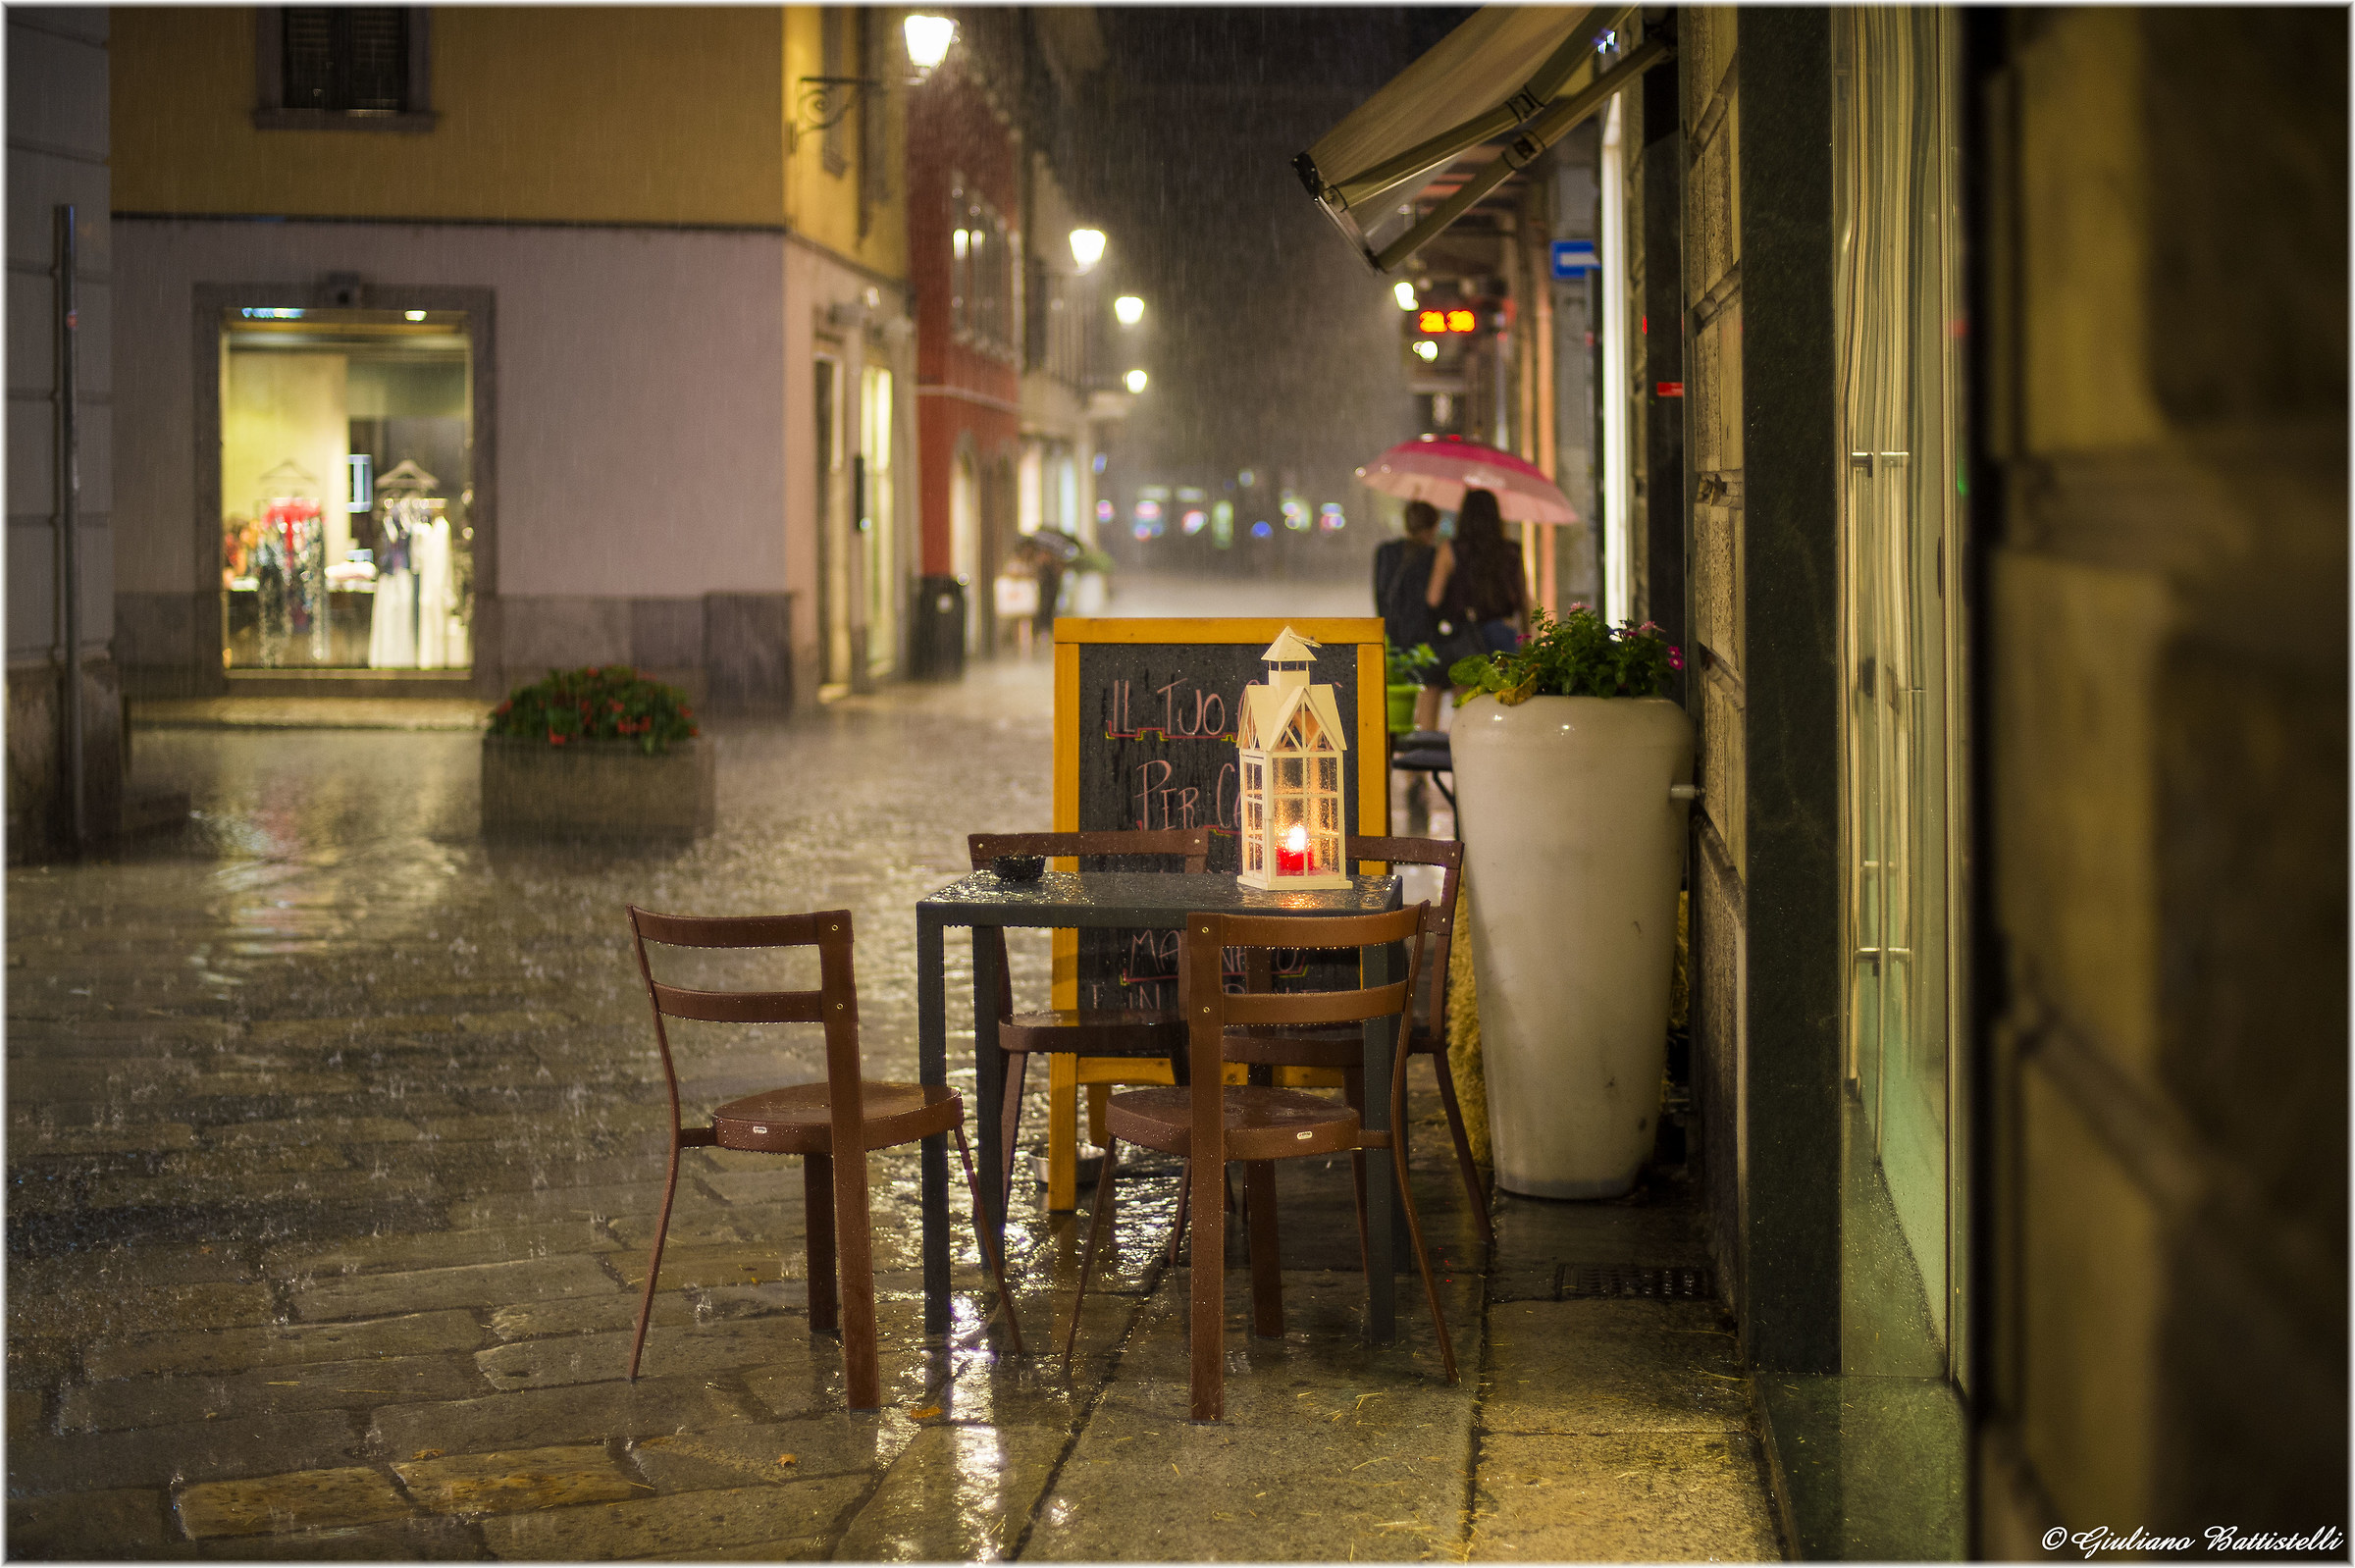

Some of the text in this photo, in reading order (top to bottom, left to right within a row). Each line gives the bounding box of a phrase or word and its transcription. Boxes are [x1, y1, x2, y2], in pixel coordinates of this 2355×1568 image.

[1113, 680, 1134, 733] IL
[1157, 677, 1226, 736] TUO
[1134, 759, 1199, 831] PER
